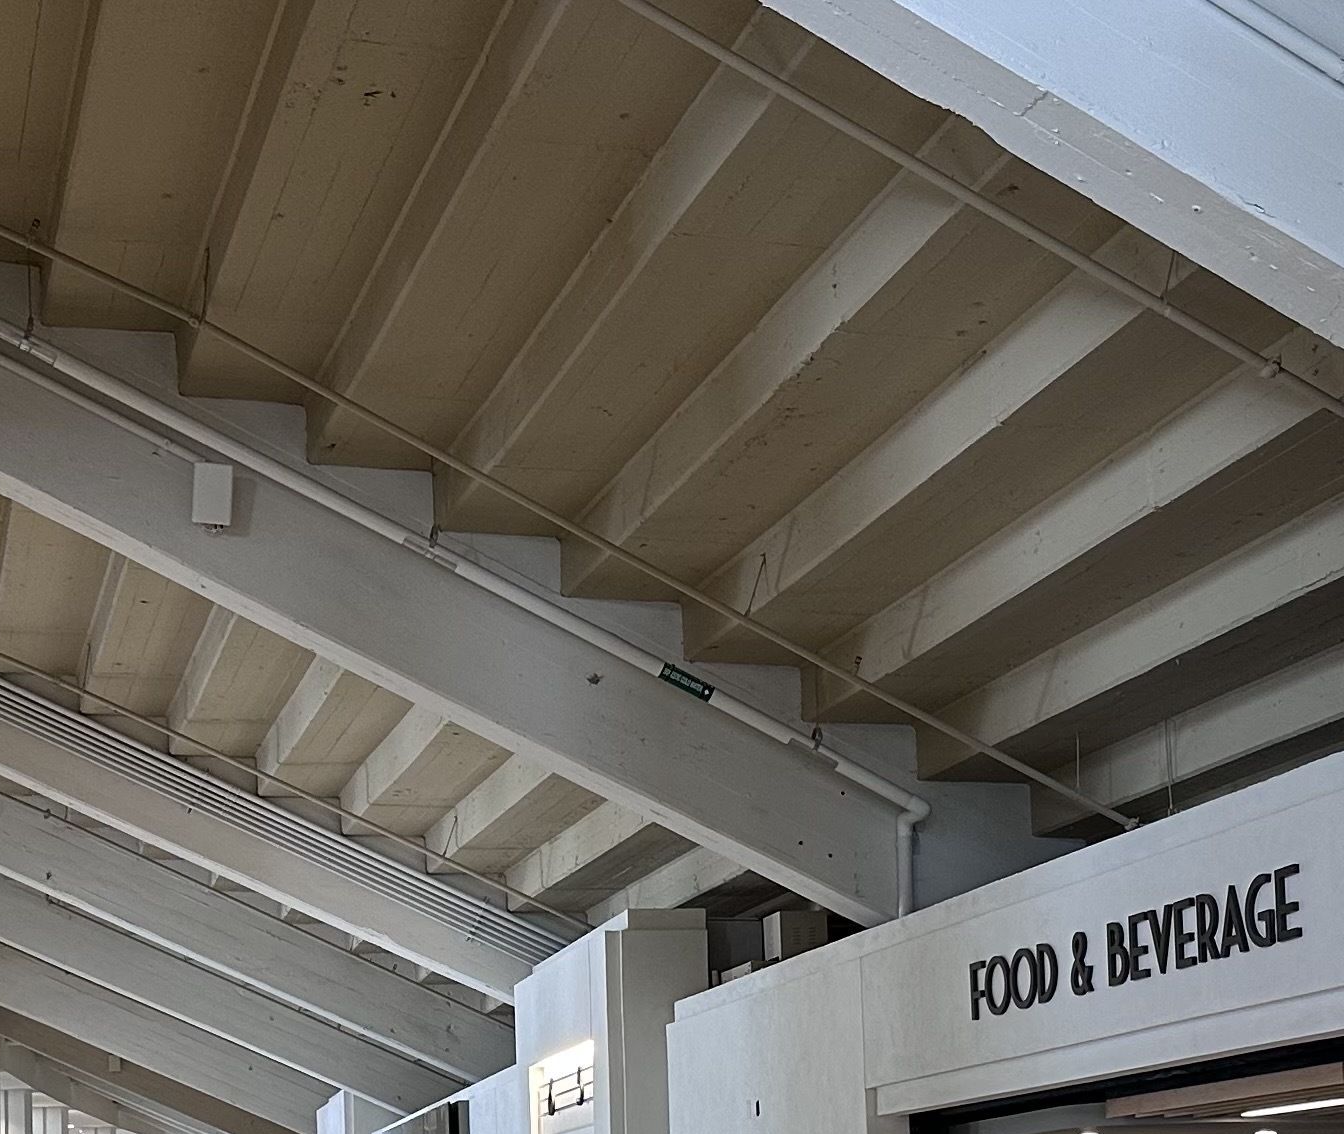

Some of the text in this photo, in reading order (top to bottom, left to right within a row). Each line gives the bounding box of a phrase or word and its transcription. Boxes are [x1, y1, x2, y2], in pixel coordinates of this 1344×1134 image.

[969, 863, 1303, 1020] FOOD & BEVERAGE
